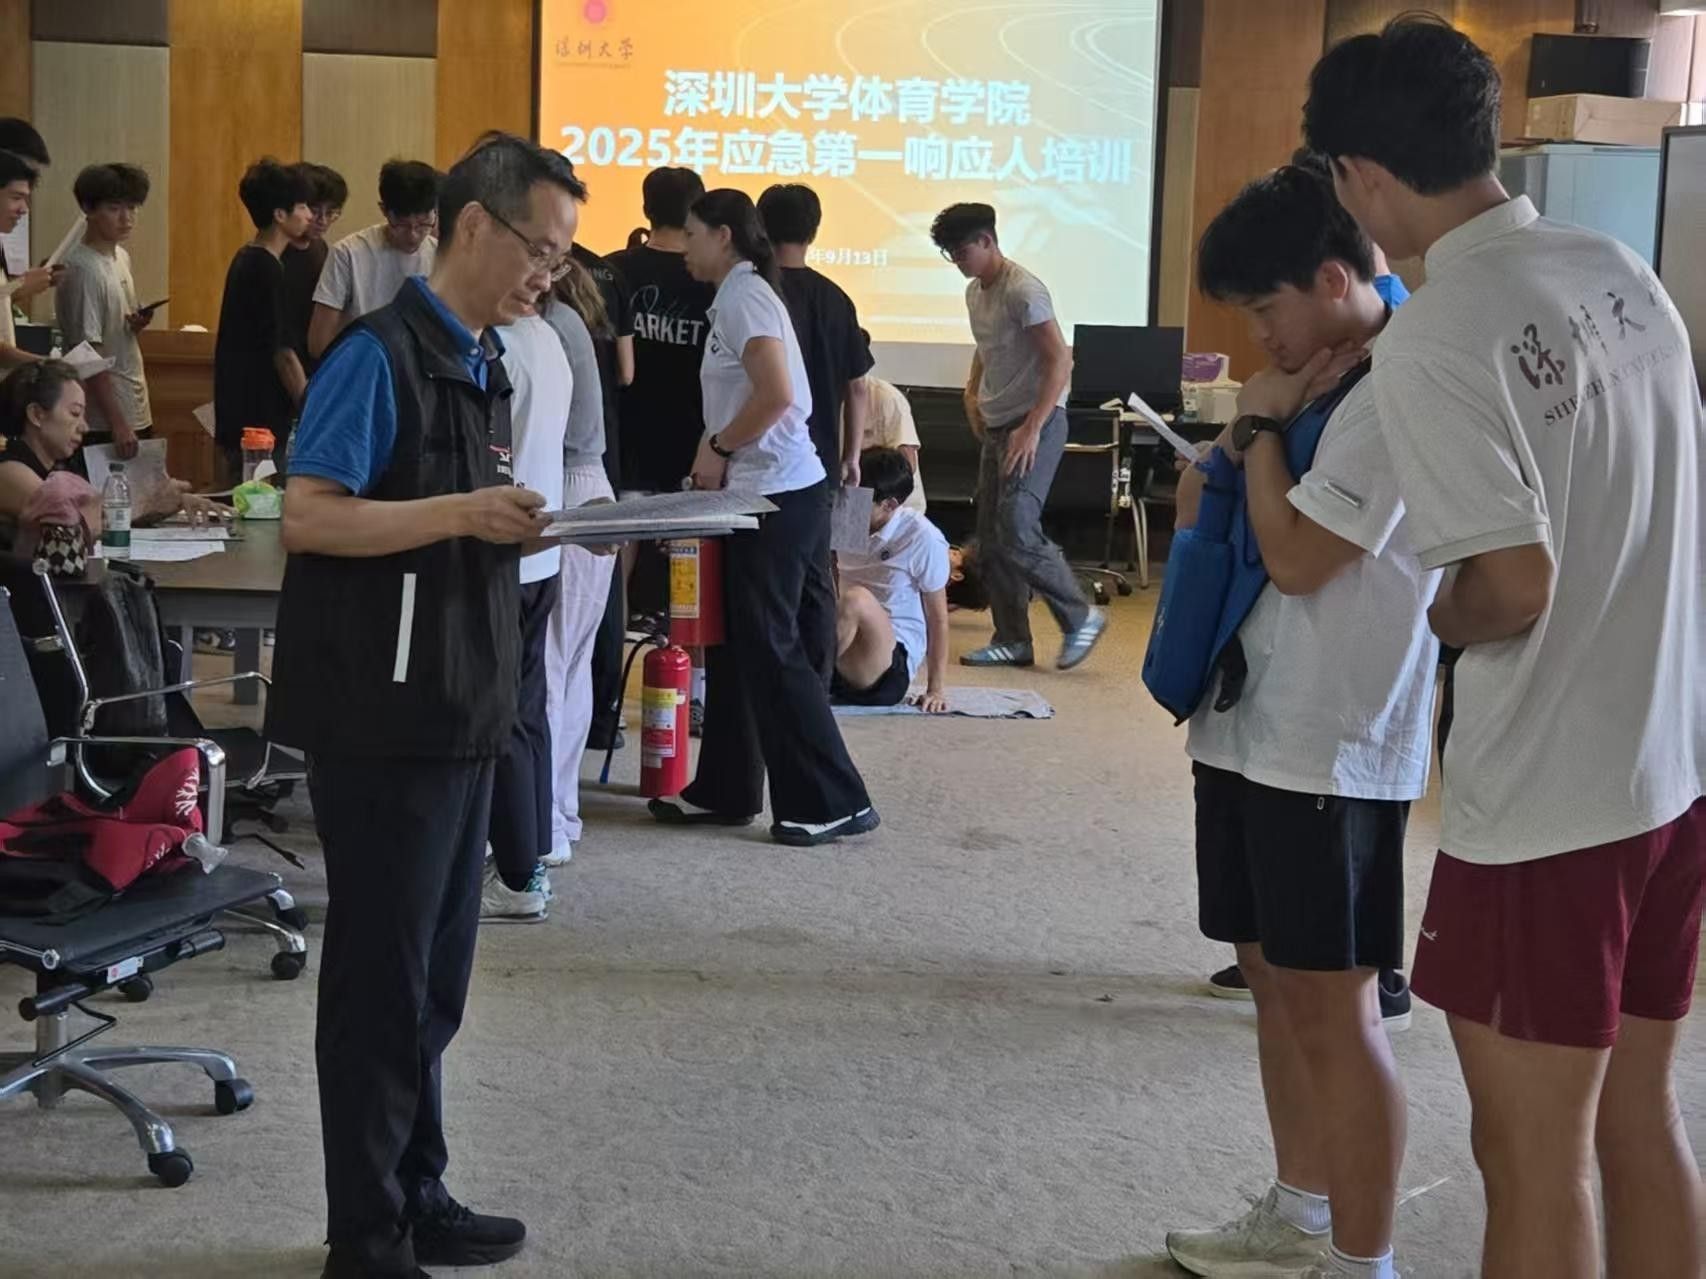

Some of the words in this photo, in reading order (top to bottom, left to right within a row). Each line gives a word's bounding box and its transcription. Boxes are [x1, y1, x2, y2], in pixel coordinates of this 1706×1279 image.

[663, 69, 1032, 126] 深圳大学体育学院
[560, 125, 1133, 184] 2025年应急第一响应人培训
[807, 248, 888, 267] 年9月13日
[633, 311, 705, 346] ARKET
